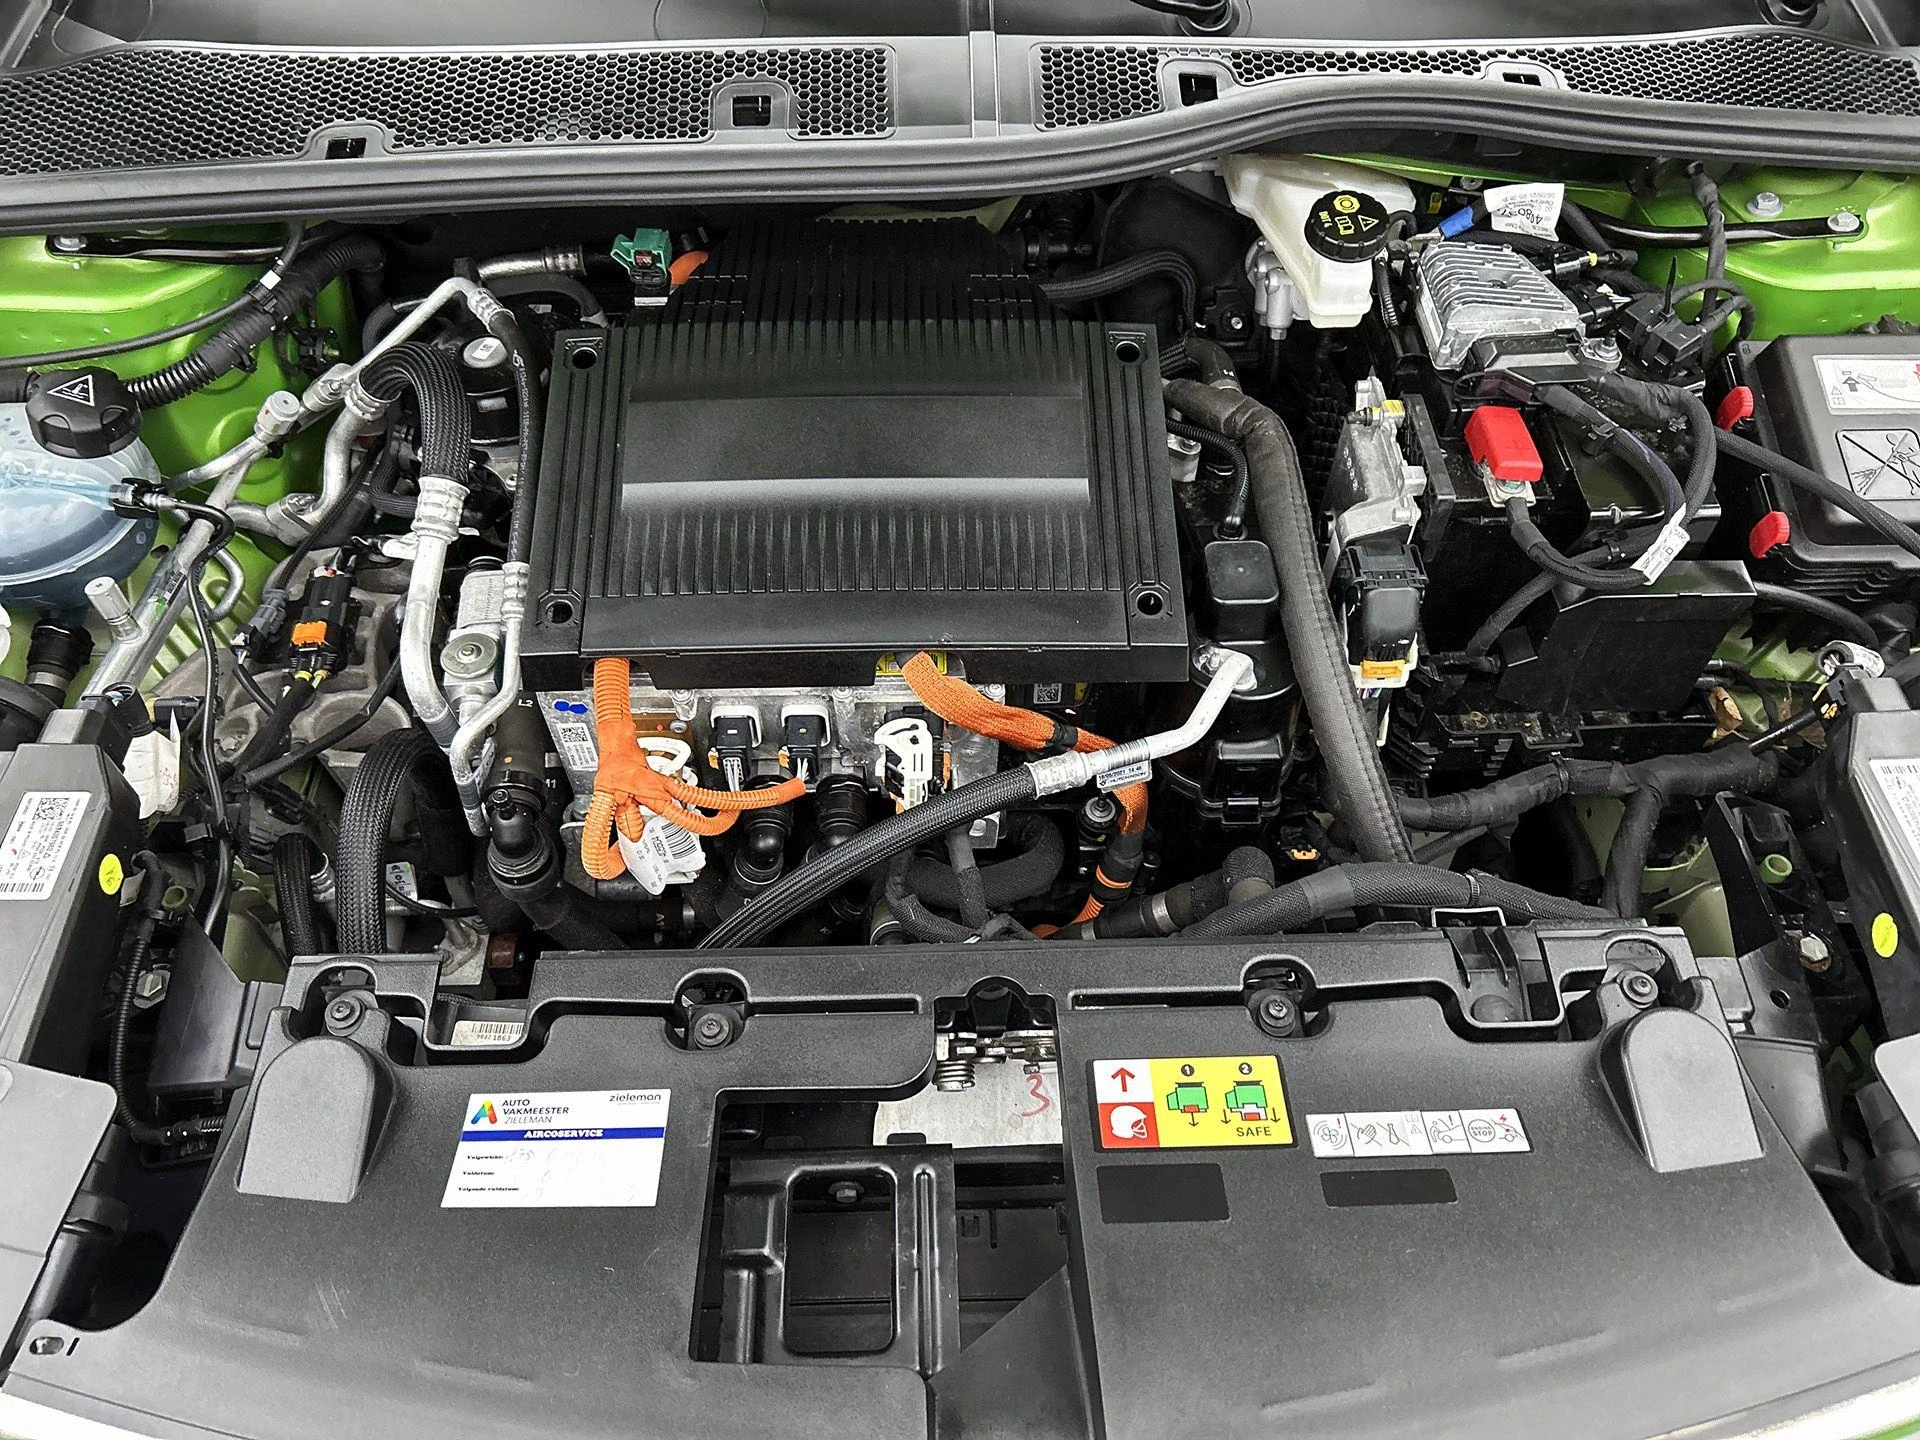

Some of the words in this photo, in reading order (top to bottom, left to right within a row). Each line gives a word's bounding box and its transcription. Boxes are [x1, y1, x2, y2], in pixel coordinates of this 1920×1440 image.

[517, 698, 534, 708] L2
[1109, 772, 1146, 782] HUTCHINSON
[609, 1092, 662, 1102] zieleman
[1021, 1073, 1050, 1117] 3
[502, 1098, 531, 1107] AUTO
[503, 1106, 570, 1116] VAKMEESTER
[504, 1115, 553, 1125] ZIELEMAN
[523, 1128, 604, 1140] AIRCOSERVICE
[1236, 1126, 1272, 1137] SAFE
